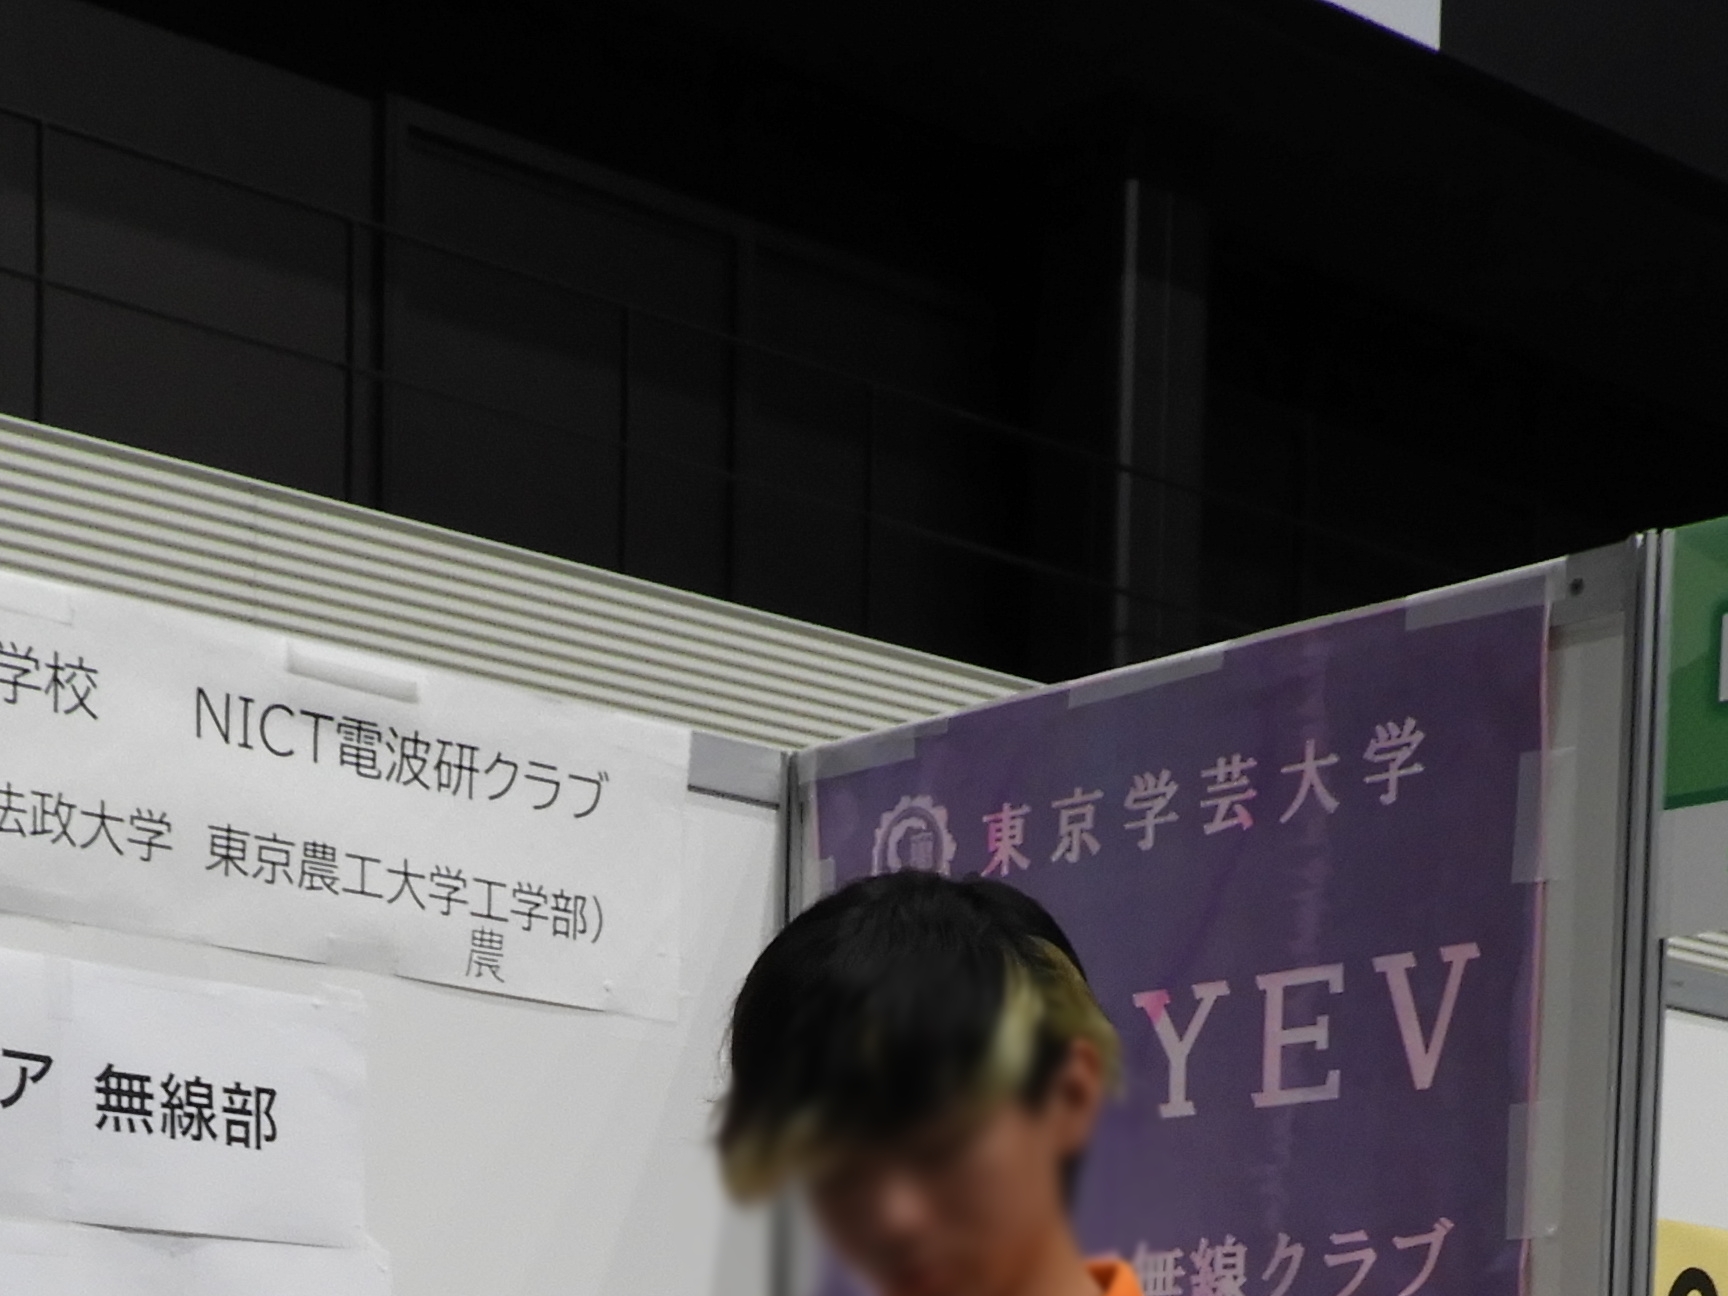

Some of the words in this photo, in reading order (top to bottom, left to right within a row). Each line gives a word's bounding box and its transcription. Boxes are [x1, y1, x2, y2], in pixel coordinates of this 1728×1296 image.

[194, 686, 611, 818] NICT電波研クラブ
[980, 715, 1427, 878] 東京学芸大学
[463, 926, 508, 984] 農
